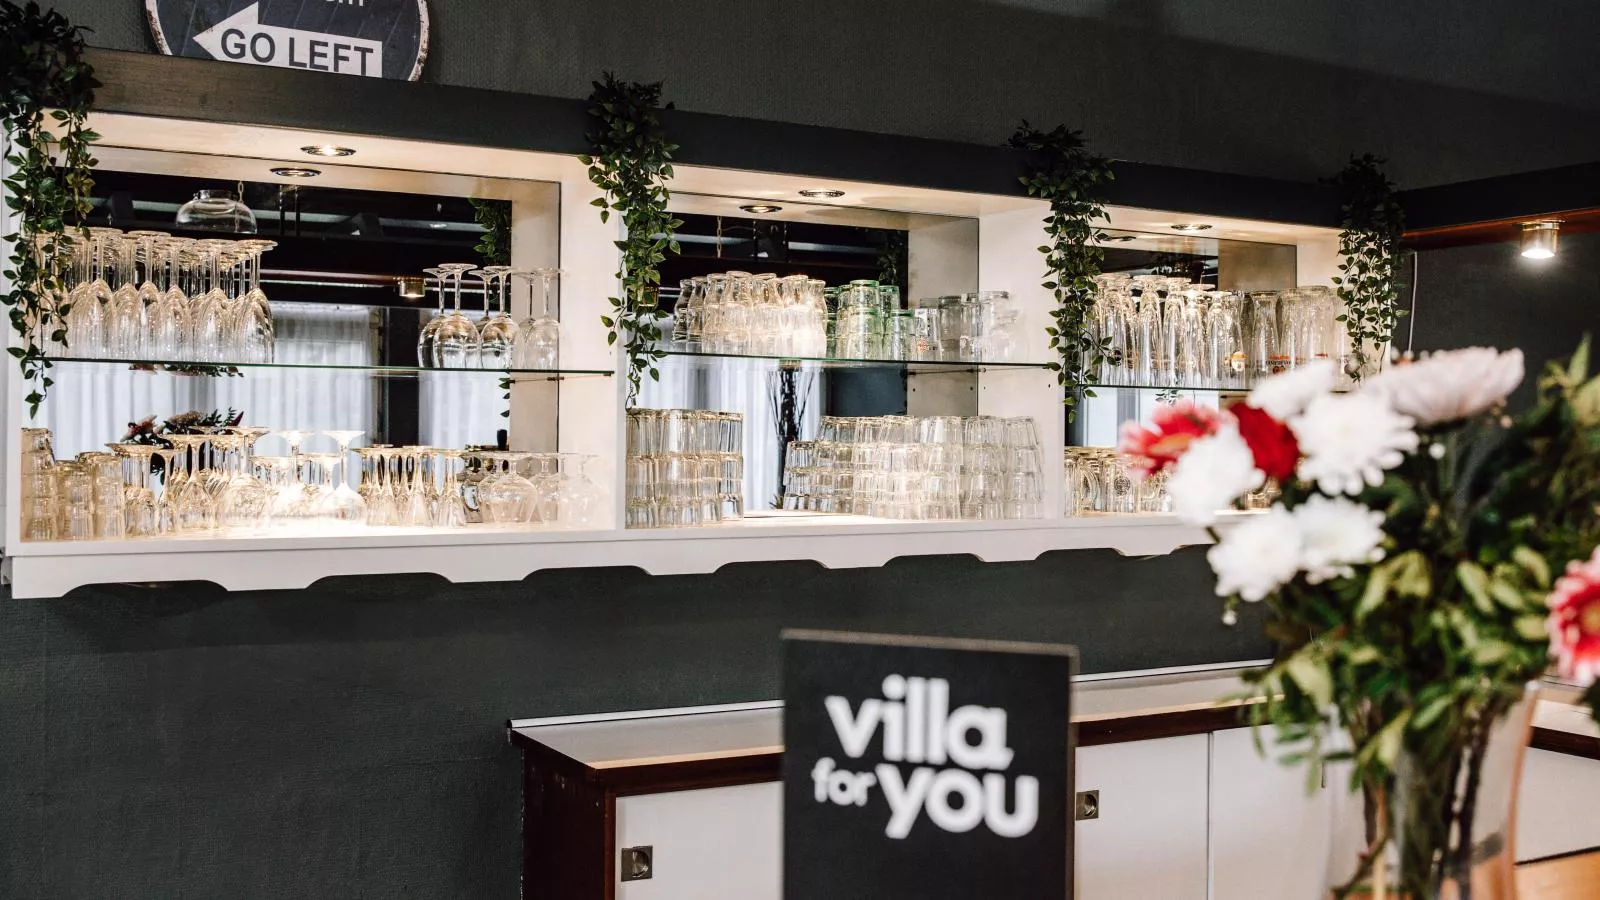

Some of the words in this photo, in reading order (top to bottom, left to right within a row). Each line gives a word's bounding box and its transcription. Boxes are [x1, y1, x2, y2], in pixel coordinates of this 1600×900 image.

[221, 28, 276, 63] GO
[289, 37, 374, 76] LEFT
[824, 674, 1014, 770] villa
[811, 757, 876, 806] for
[875, 763, 1039, 839] you
